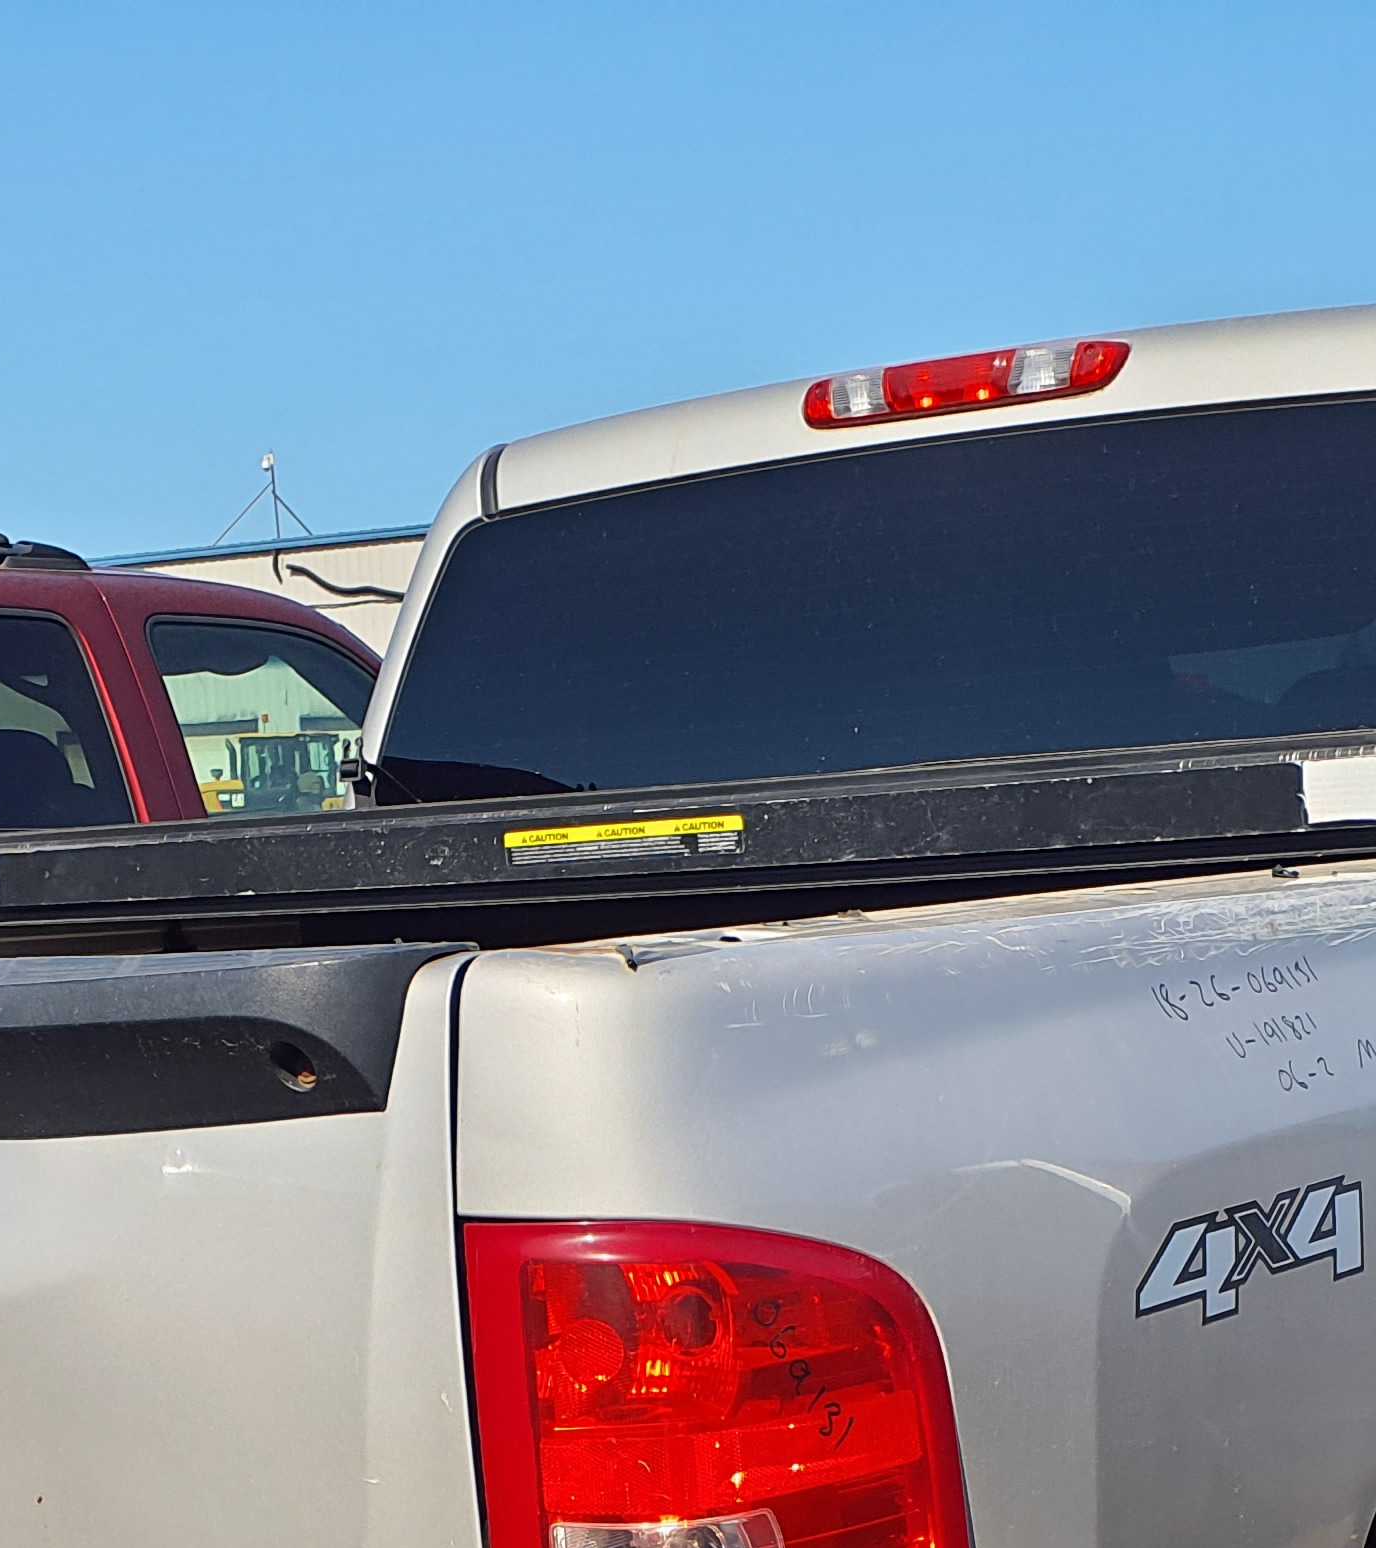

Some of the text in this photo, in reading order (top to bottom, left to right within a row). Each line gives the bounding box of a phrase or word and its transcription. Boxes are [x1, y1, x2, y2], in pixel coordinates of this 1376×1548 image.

[528, 820, 725, 843] CAUTION CAUTION CAUTION
[1226, 1011, 1317, 1059] U-191821
